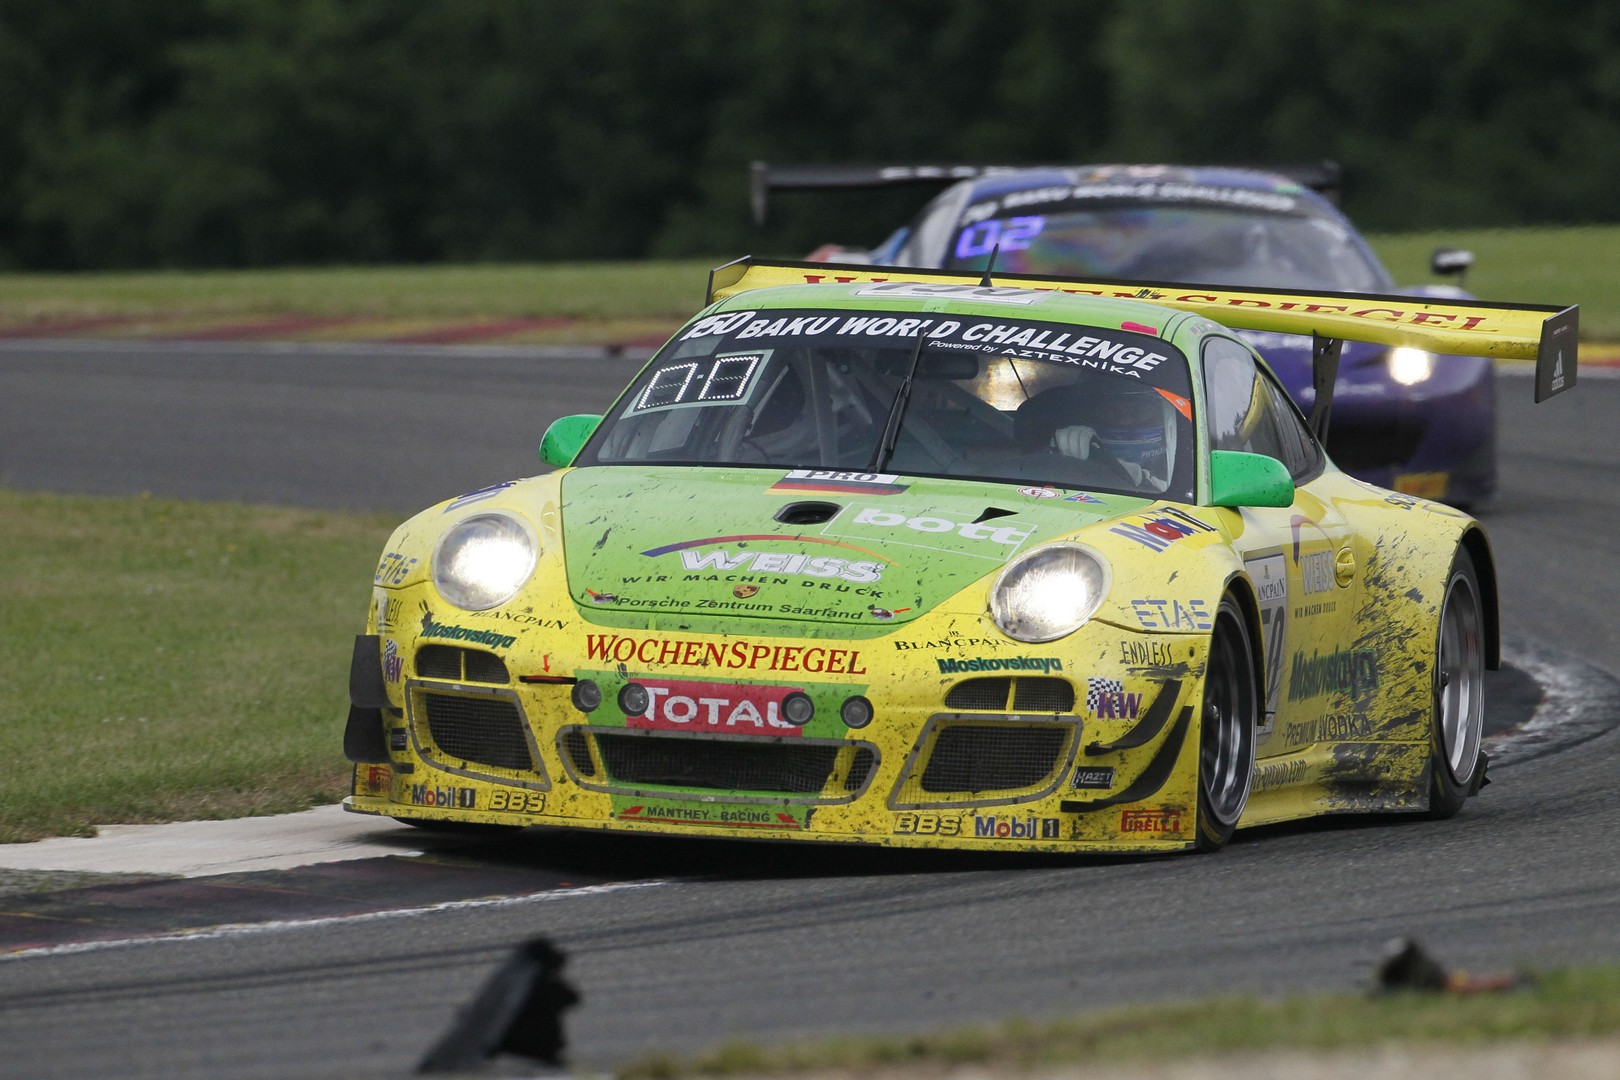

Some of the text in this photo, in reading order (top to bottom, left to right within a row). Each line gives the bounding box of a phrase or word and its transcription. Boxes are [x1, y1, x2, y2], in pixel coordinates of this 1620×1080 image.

[679, 311, 1167, 371] 150 BAKU WORLD CHALLENGE
[928, 340, 982, 351] Powered
[981, 345, 999, 354] by
[805, 470, 878, 481] PRO
[852, 508, 1029, 545] bott
[678, 550, 888, 584] WEISS
[1300, 550, 1335, 595] WEISS
[622, 574, 886, 599] WIR MACHEN DRUCK
[1258, 578, 1286, 600] ANCPAIN
[616, 597, 865, 620] Porsche Zentrum Saarland
[420, 620, 517, 650] Moskovskaya
[894, 638, 1019, 650] BLANCPAIN
[586, 634, 868, 675] WOCHENSPIEGEL
[1119, 640, 1173, 666] ENDLESS
[936, 656, 1064, 674] Moskovskaya
[644, 687, 797, 729] TOTAL
[1096, 692, 1143, 720] KW
[1075, 772, 1112, 784] HAZET
[411, 784, 475, 808] Mobil 1
[488, 790, 547, 813] BBS
[647, 807, 771, 823] MANTHEY RACING
[893, 814, 962, 836] BBS
[1120, 810, 1182, 833] PIRELLI
[974, 816, 1058, 839] Mobil 1
